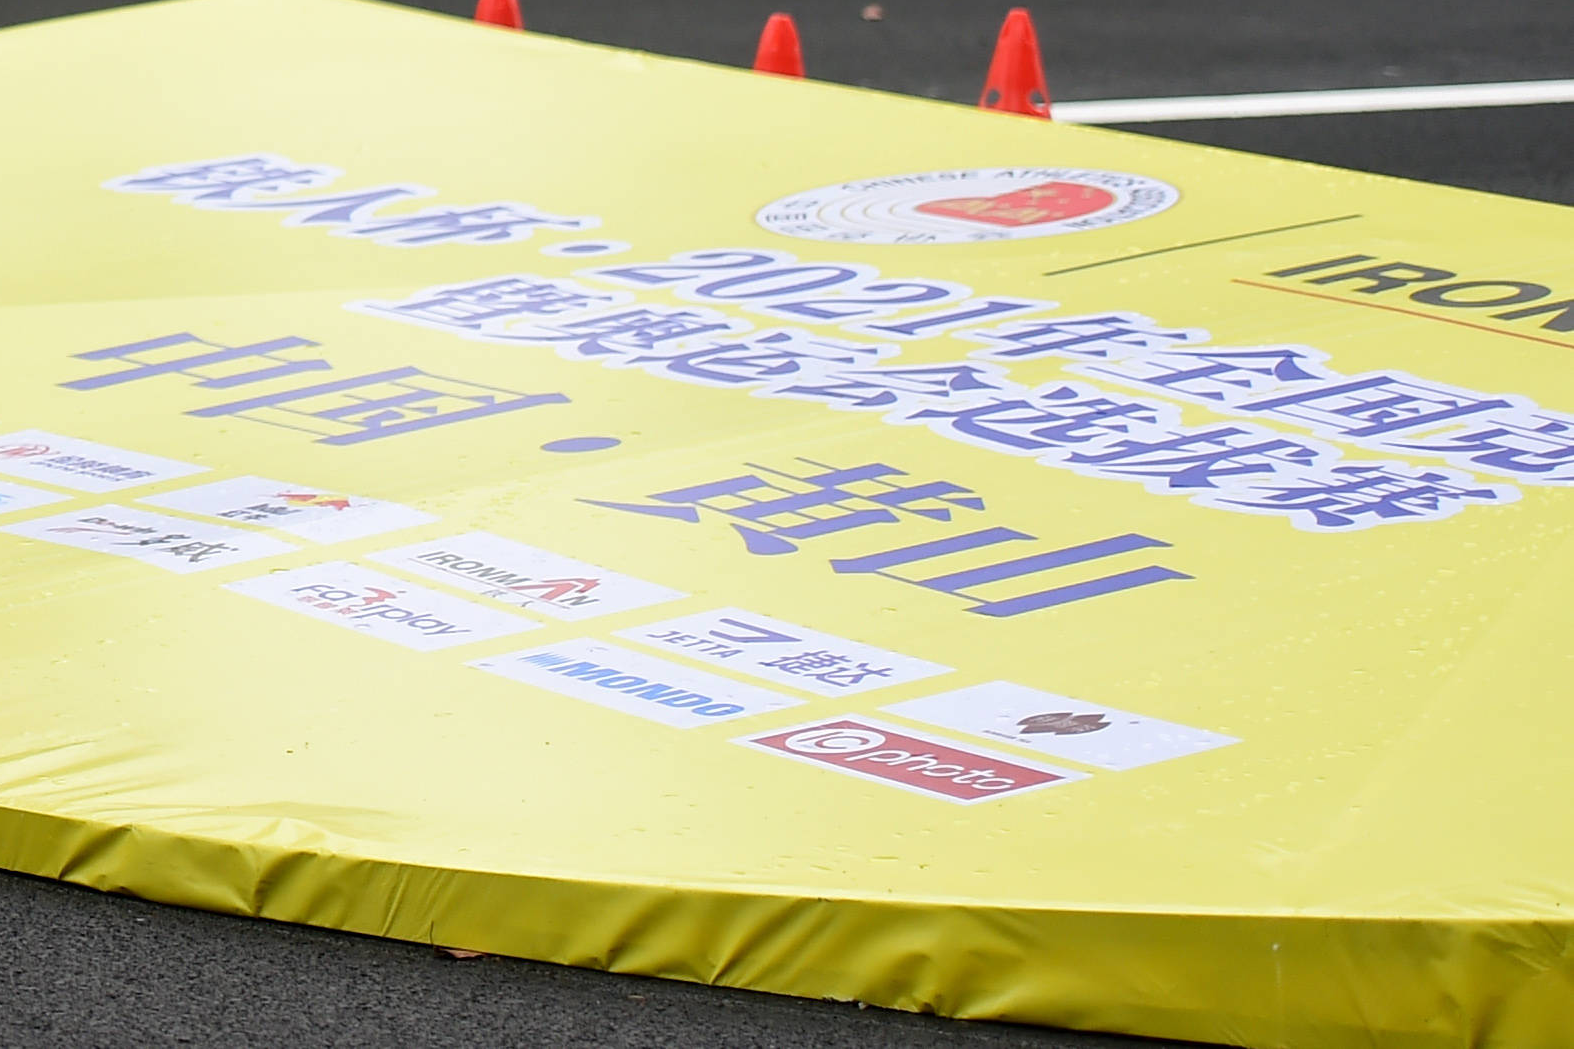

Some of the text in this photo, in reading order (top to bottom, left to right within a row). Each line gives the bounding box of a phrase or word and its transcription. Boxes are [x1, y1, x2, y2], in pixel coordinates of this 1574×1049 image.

[124, 157, 1574, 480] 铁人杯·2021年全国竞
[363, 278, 1499, 526] 暨奥运会选拔赛
[646, 629, 745, 658] JETTA
[756, 649, 894, 687] 捷达
[550, 659, 745, 717] MONDO
